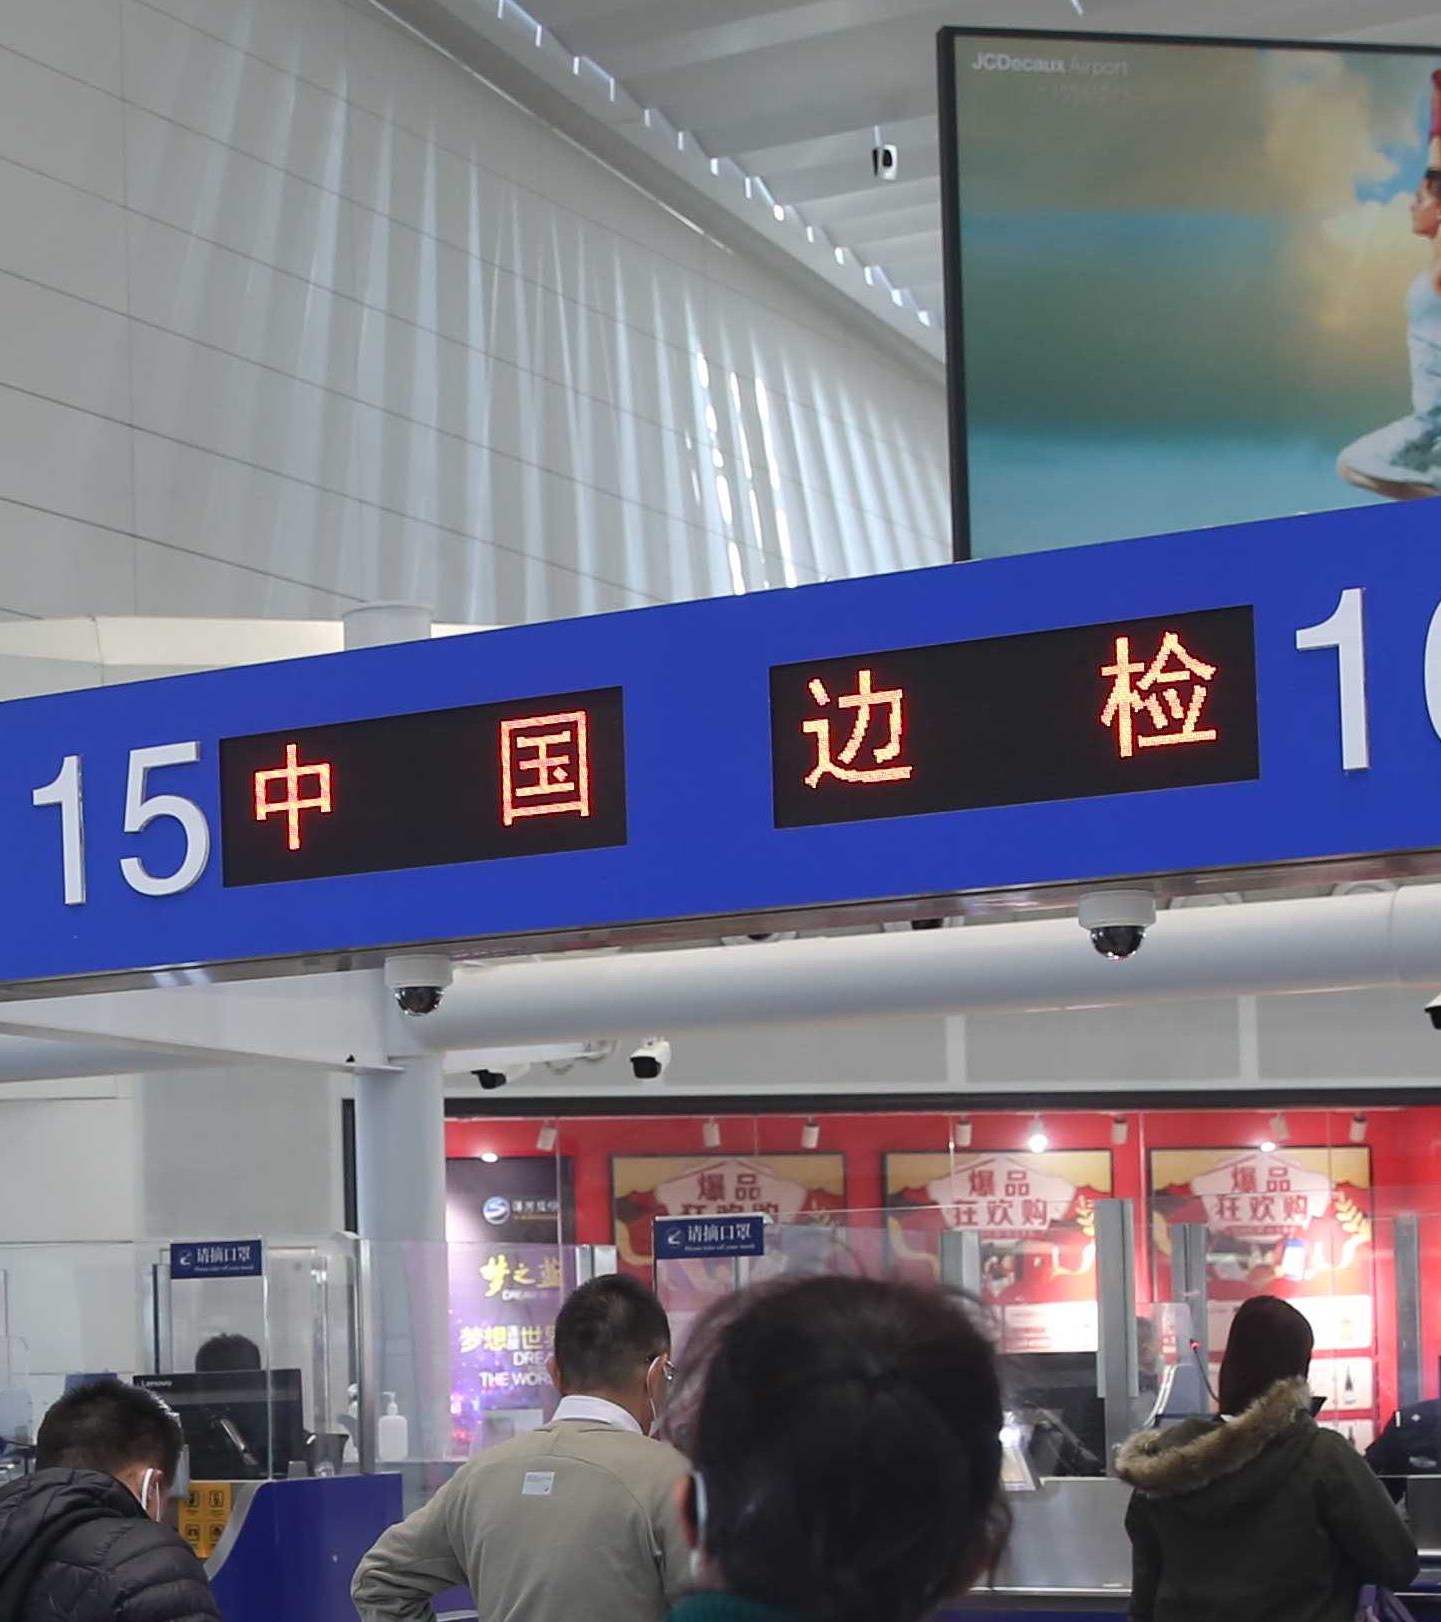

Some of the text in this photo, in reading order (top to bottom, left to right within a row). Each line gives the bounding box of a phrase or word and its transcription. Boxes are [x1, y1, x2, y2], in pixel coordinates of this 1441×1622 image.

[253, 709, 591, 850] 中国
[804, 632, 1217, 788] 边检
[33, 742, 209, 906] 15
[688, 1223, 751, 1242] 请摘口罩
